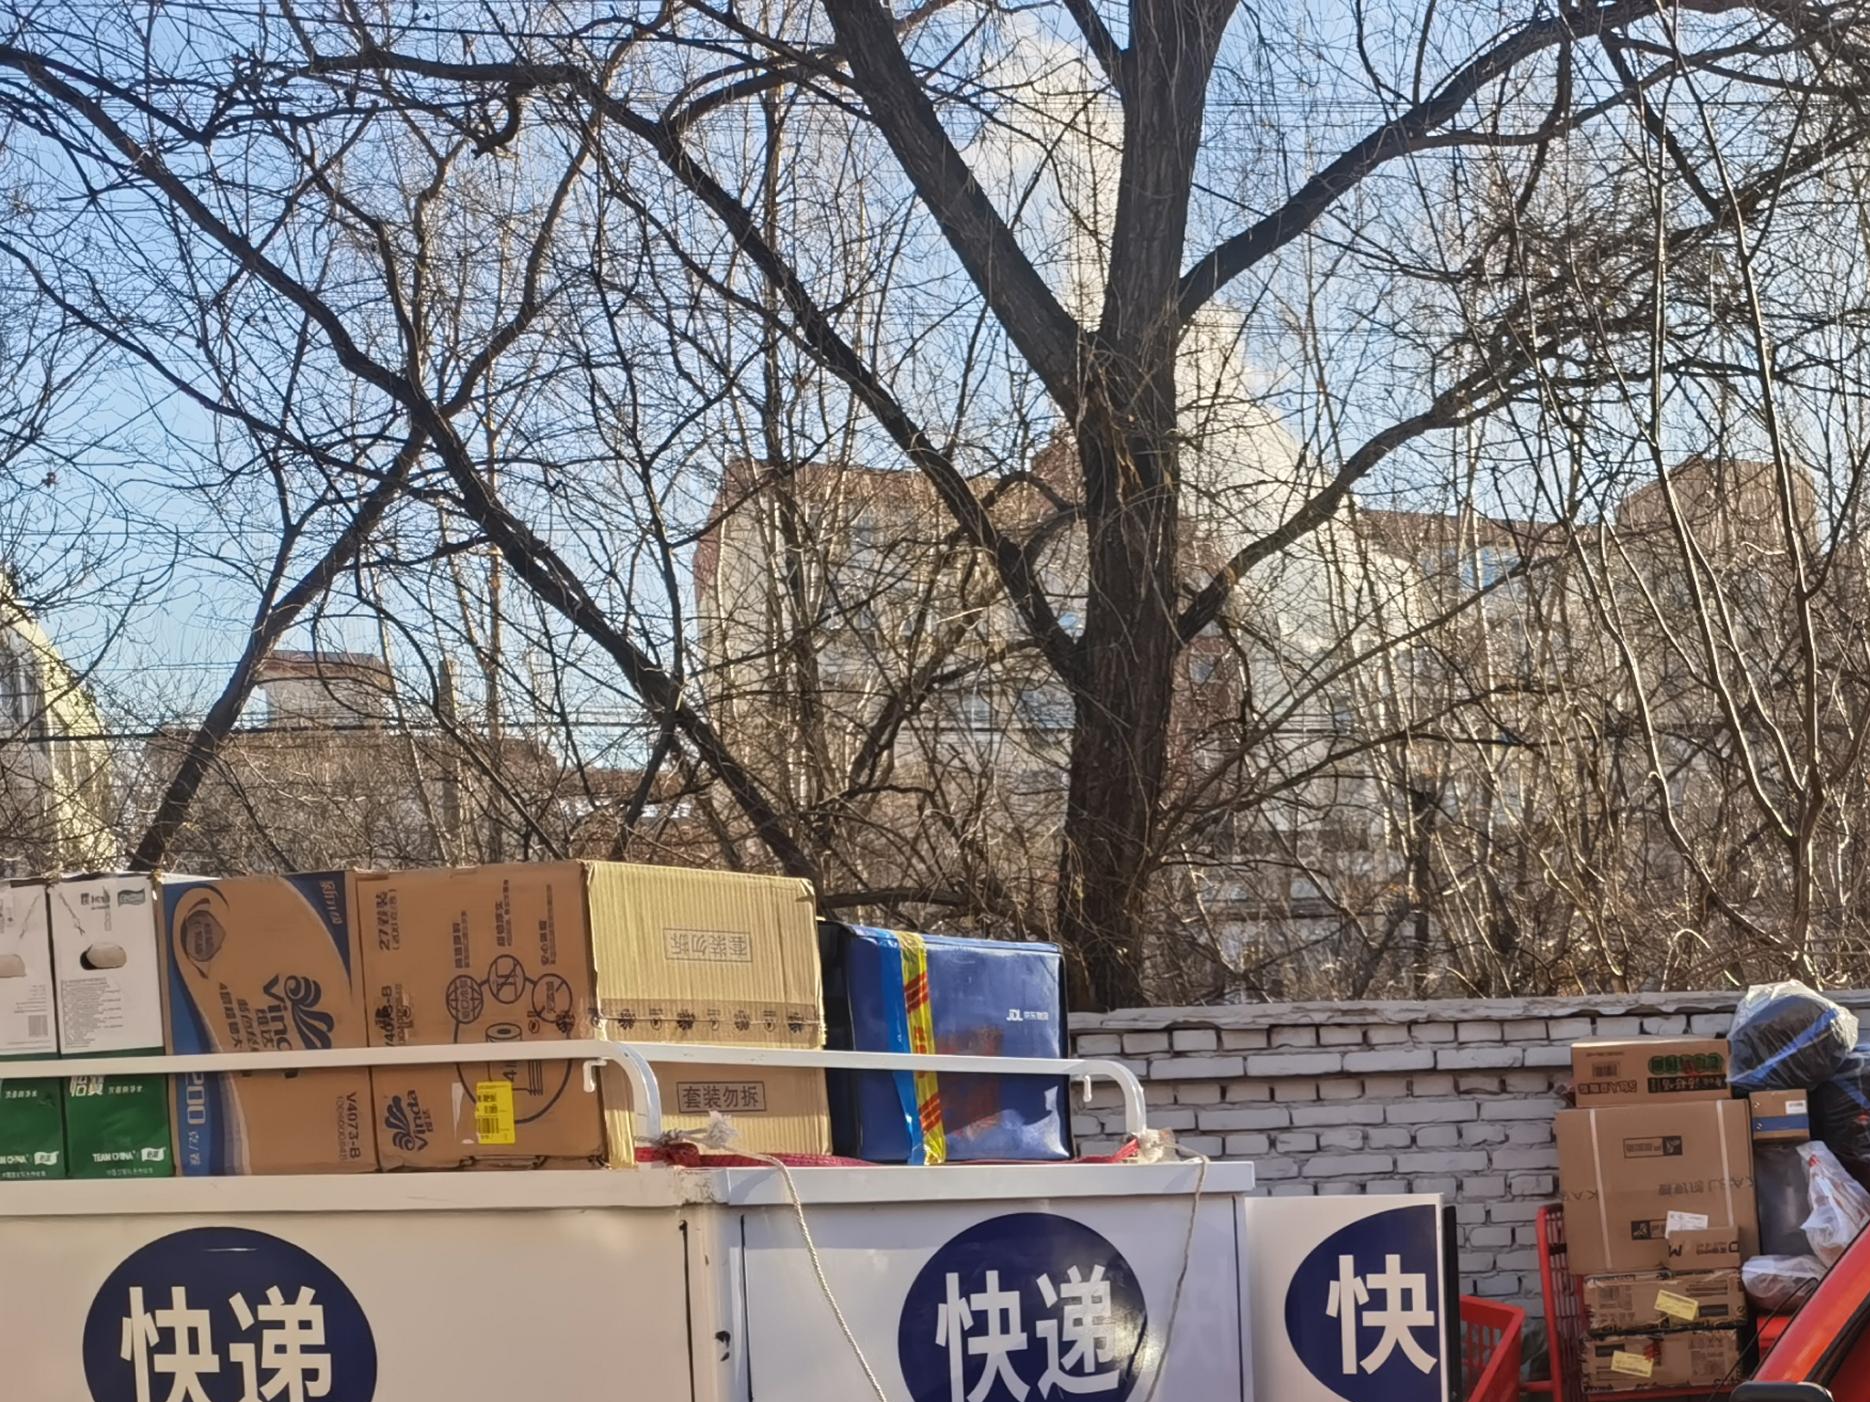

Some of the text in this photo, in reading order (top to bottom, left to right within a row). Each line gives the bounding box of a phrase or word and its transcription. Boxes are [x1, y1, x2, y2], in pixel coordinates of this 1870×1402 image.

[670, 932, 748, 957] 套装勿拆
[681, 1086, 759, 1109] 套装勿拆
[404, 1090, 430, 1152] Vinda
[1325, 1253, 1439, 1376] 快
